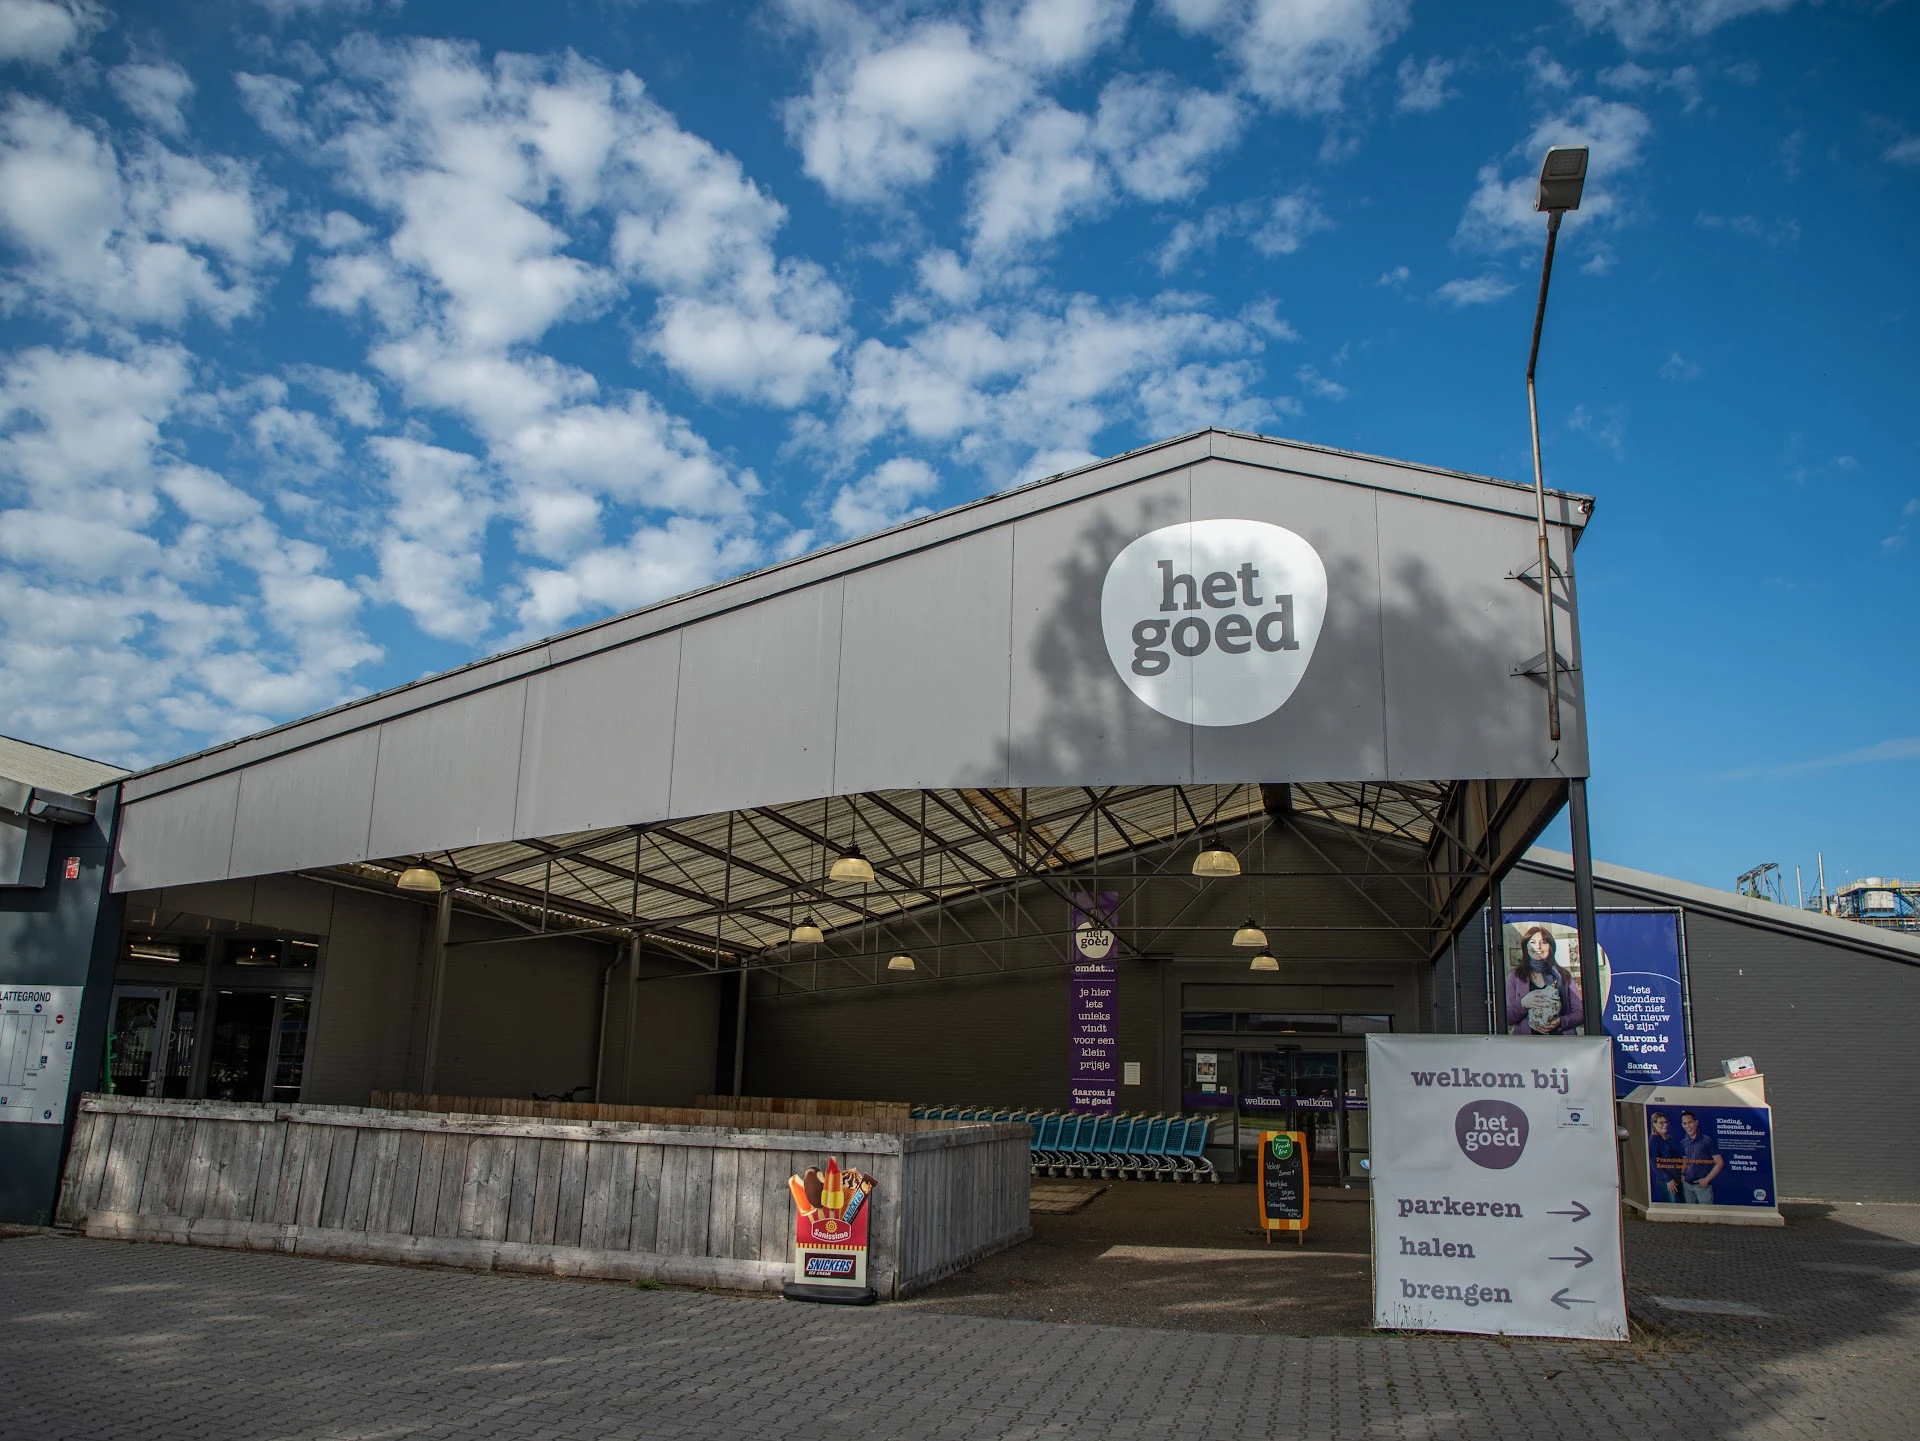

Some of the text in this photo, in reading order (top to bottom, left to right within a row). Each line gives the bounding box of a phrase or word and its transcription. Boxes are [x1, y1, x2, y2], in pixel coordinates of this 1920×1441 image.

[1157, 560, 1263, 612] het
[1131, 594, 1300, 677] goed
[1081, 936, 1109, 949] goed
[1079, 988, 1111, 998] je hier
[1085, 1000, 1103, 1009] iets
[1614, 995, 1666, 1004] bijzonders
[1616, 1004, 1665, 1013] hoeft niet
[1078, 1012, 1111, 1021] unieks
[1612, 1013, 1670, 1023] altijd nieuw
[1081, 1024, 1107, 1032] vindt
[1624, 1022, 1634, 1030] te
[1073, 1037, 1115, 1045] voor een
[1616, 1034, 1669, 1043] daarom is
[1082, 1048, 1106, 1057] klein
[1621, 1043, 1666, 1054] het goed
[1080, 1061, 1110, 1071] prijsje
[1627, 1062, 1658, 1070] Sandra
[1411, 1068, 1569, 1094] welkom bij
[1072, 1088, 1116, 1097] daarom is
[1091, 1097, 1112, 1106] goed
[1245, 1097, 1281, 1106] welkom
[1296, 1098, 1333, 1107] welkom
[1473, 1112, 1508, 1132] het
[1465, 1128, 1520, 1151] goed
[1398, 1196, 1523, 1218] parkeren
[813, 1228, 849, 1240] Sanissimo
[1399, 1236, 1475, 1259] halen
[807, 1258, 853, 1272] SNICKERS
[1400, 1278, 1513, 1307] brengen
